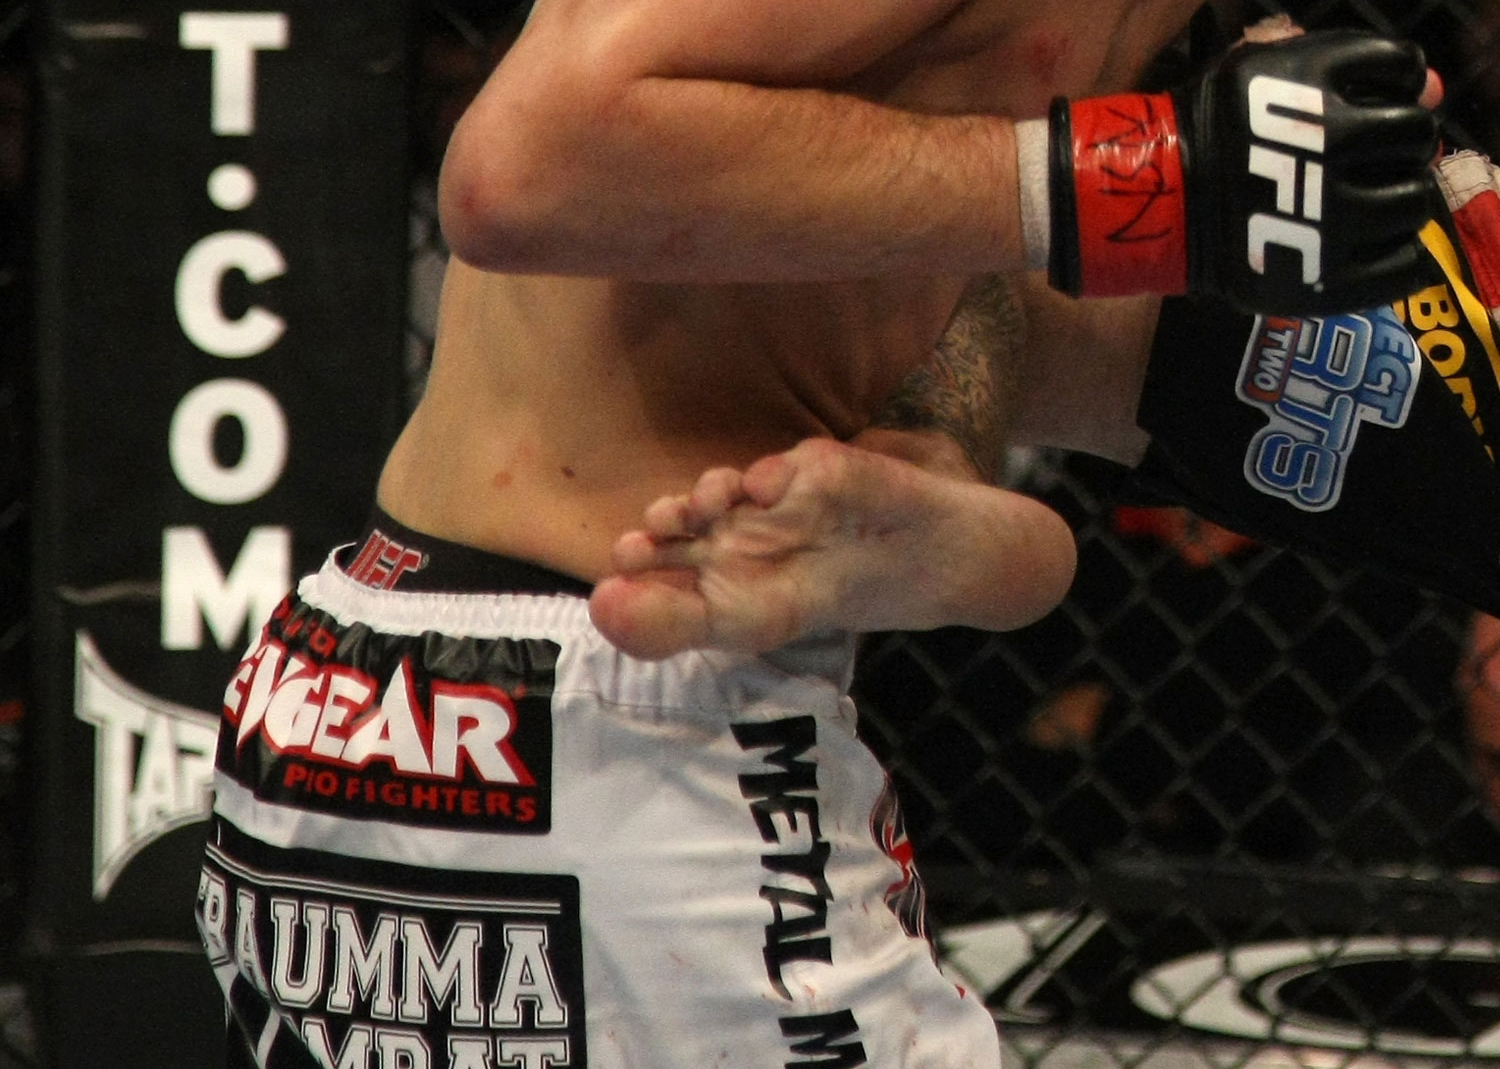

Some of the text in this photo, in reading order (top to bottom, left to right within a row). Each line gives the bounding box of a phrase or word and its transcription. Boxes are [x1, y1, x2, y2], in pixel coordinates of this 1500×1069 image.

[1247, 74, 1326, 286] UFC
[1253, 328, 1293, 392] TWO
[1358, 306, 1416, 424] ECT
[74, 630, 220, 902] TAP
[222, 644, 534, 786] EVGEAR
[344, 779, 537, 823] FIGHTERS
[730, 715, 834, 1002] METAL
[198, 870, 569, 1029] RAUMMA
